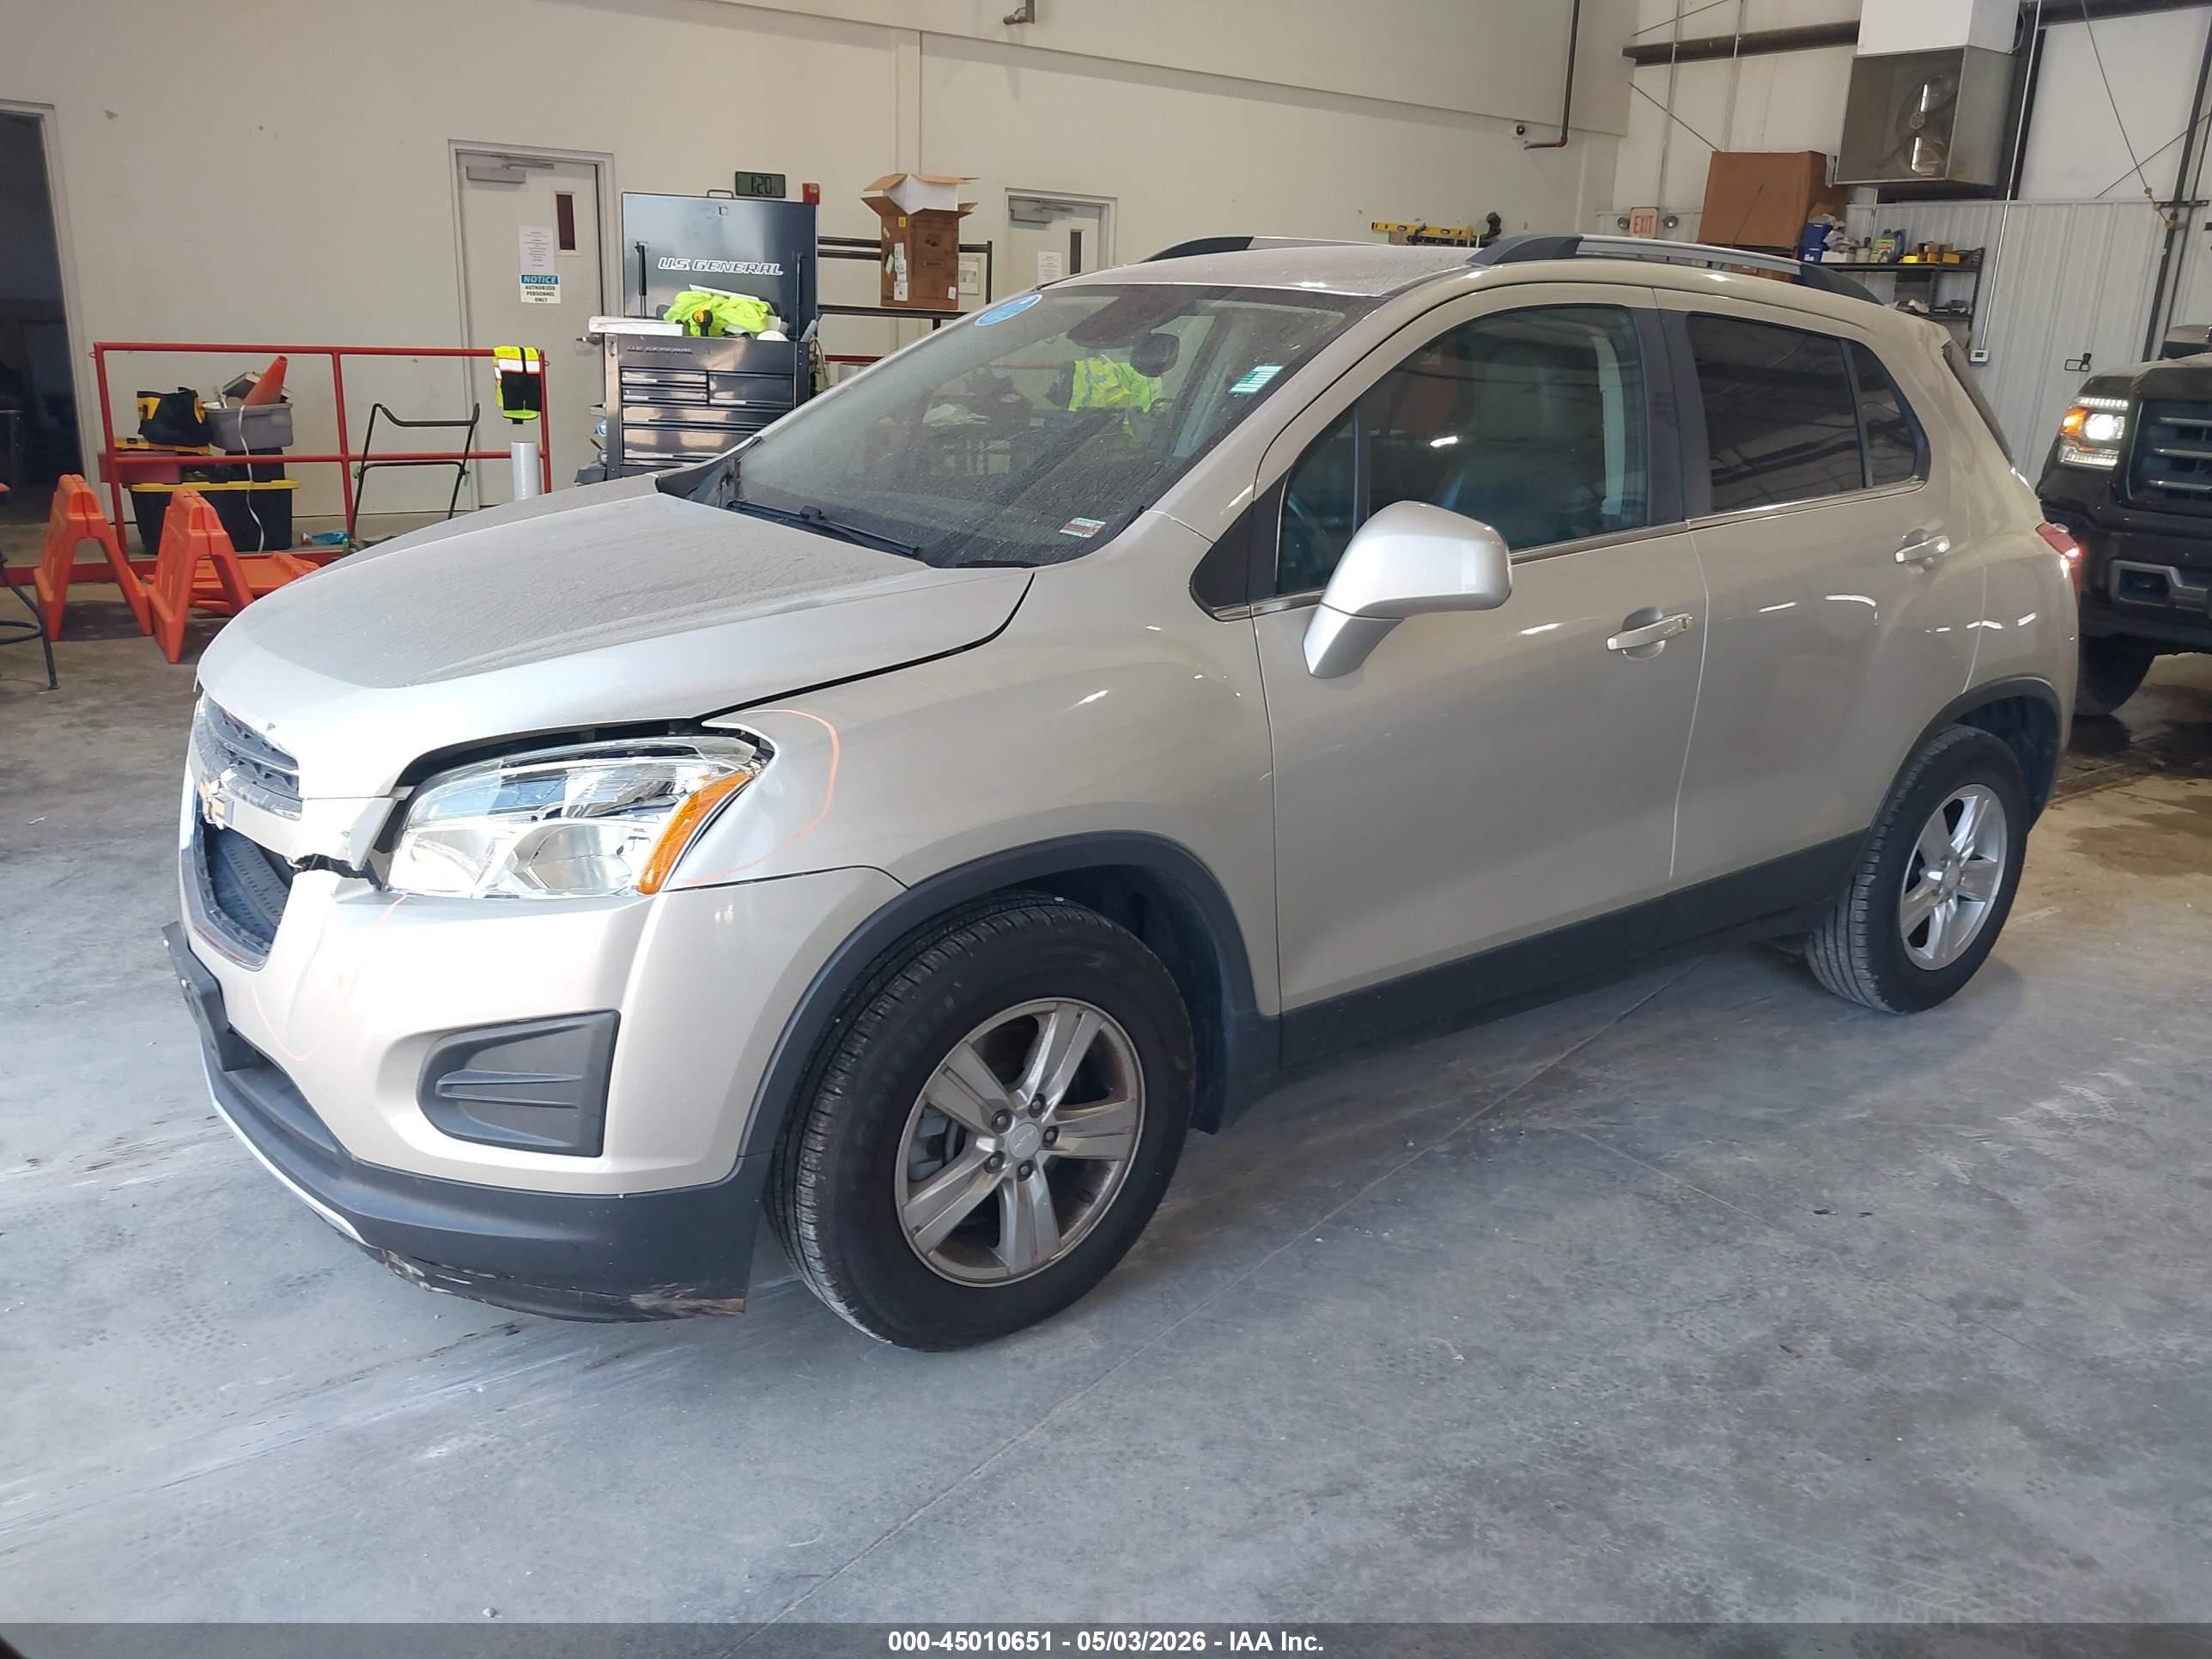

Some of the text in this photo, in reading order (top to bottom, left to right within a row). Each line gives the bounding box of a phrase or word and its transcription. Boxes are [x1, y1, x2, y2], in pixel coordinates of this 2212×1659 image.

[1633, 215, 1654, 234] EXIT
[692, 259, 784, 276] GENERAL
[522, 275, 557, 284] NOTICE
